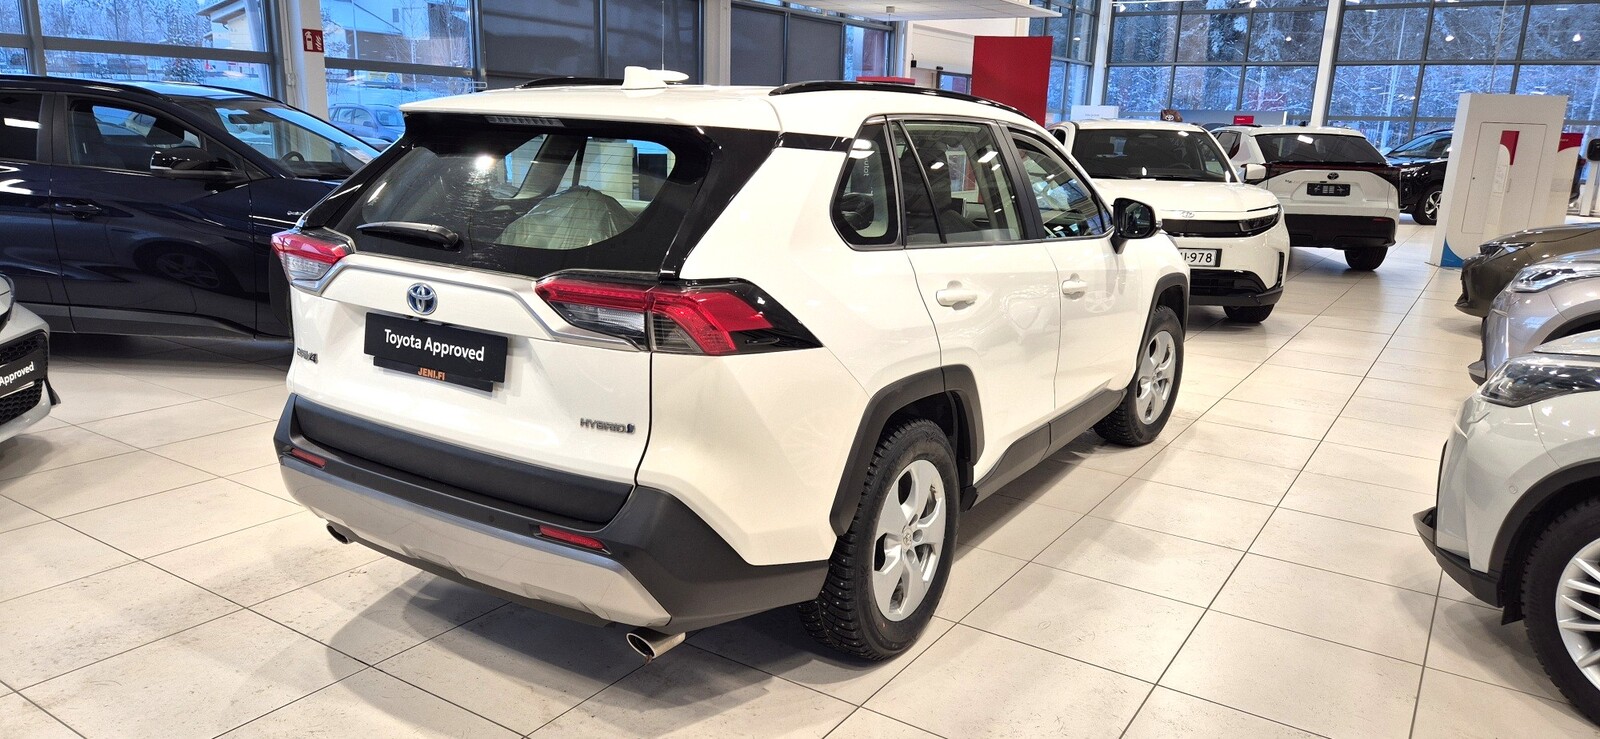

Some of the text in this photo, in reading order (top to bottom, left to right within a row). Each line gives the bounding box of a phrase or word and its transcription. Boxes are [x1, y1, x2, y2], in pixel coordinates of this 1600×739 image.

[384, 328, 485, 362] Toyota Approved
[0, 360, 35, 387] Approved
[417, 367, 446, 381] JENI.FI
[580, 417, 627, 434] HYBRID
